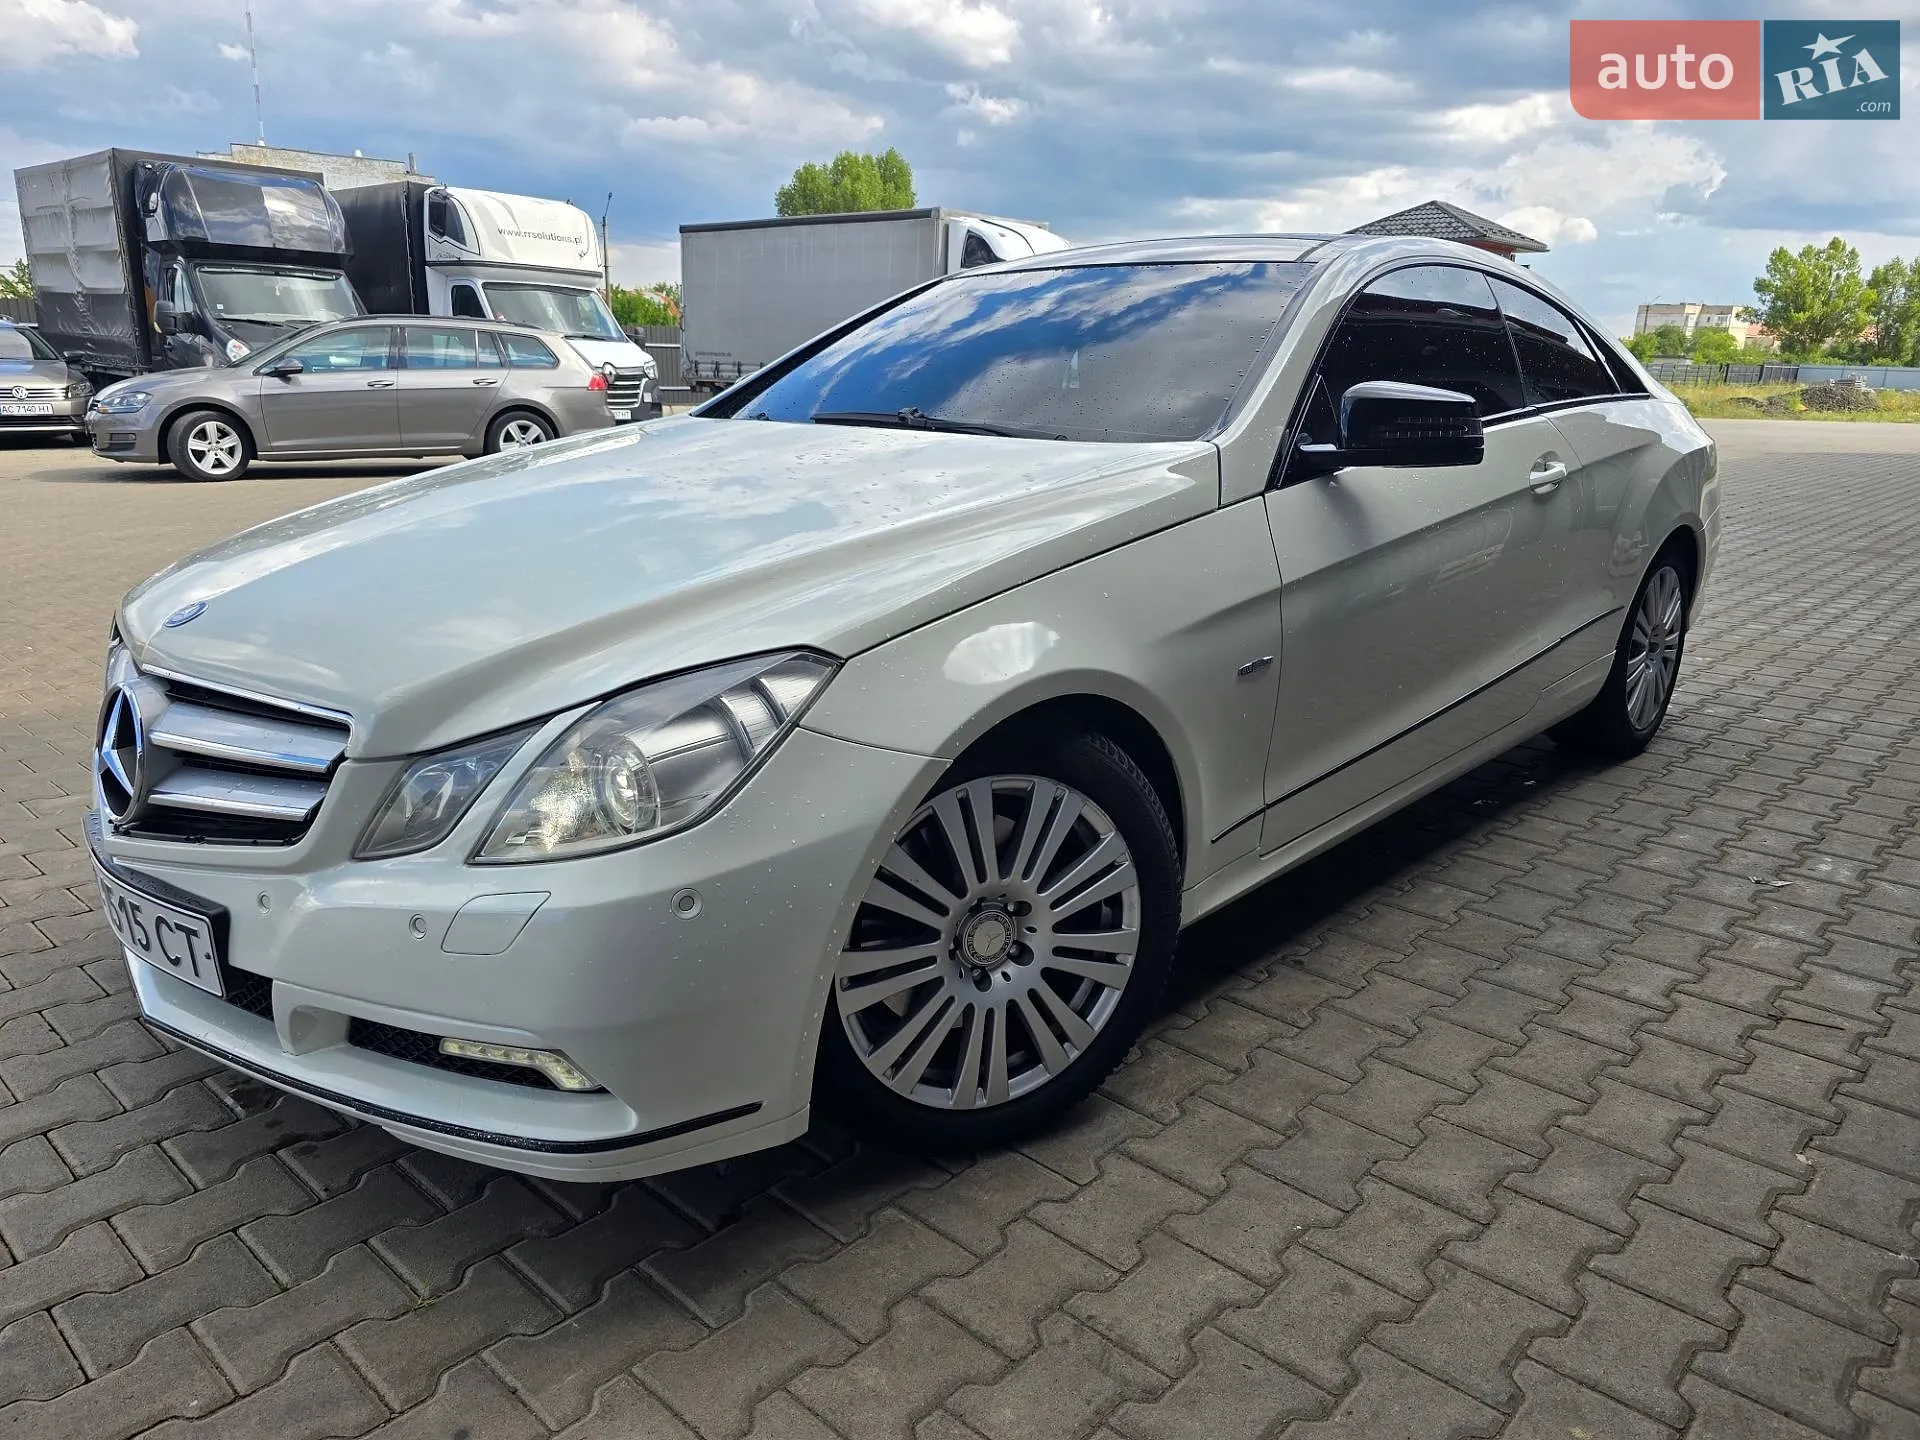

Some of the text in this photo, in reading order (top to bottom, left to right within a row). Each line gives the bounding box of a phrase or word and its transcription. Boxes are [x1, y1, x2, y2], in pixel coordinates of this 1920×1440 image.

[497, 227, 583, 245] www.rrsolutions.pl
[100, 877, 200, 978] 515 CT
